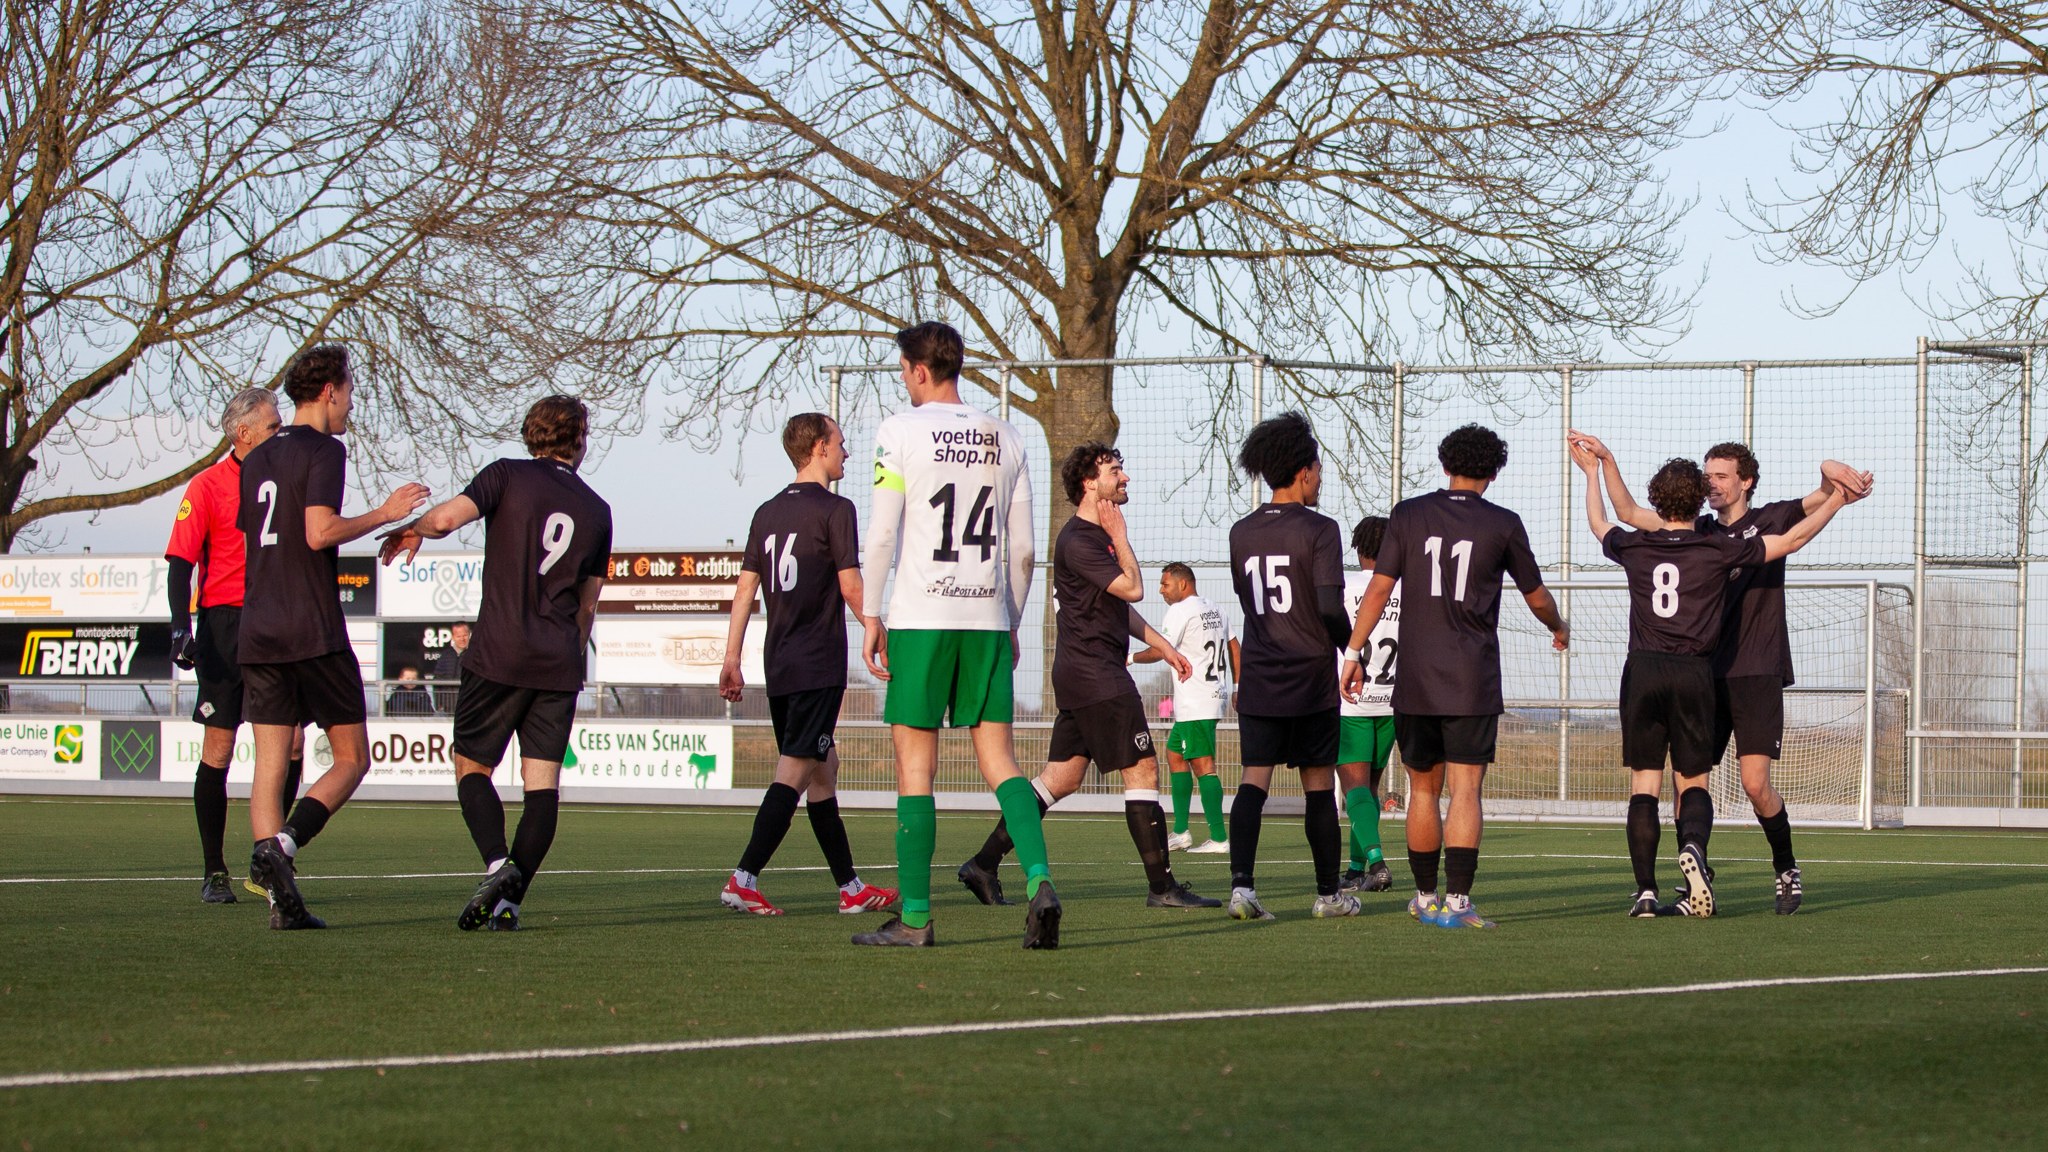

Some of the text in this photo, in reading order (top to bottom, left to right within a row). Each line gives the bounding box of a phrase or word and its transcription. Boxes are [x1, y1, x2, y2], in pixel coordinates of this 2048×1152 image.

[932, 429, 1000, 448] voetbal
[934, 445, 1001, 468] shop.nl
[257, 480, 278, 548] 2
[928, 483, 997, 563] 14
[538, 512, 575, 576] 9
[399, 561, 437, 583] Slof
[457, 561, 481, 583] Wi
[633, 556, 676, 578] Oude
[680, 556, 743, 580] Rechthu
[764, 533, 798, 592] 16
[1425, 536, 1473, 601] 11
[0, 564, 138, 594] olytex stoffen
[338, 574, 369, 588] ntage
[1244, 555, 1292, 615] 15
[1652, 562, 1679, 618] 8
[339, 590, 354, 602] 88
[655, 588, 690, 598] Feestzaal
[699, 588, 725, 599] Slijterij
[634, 603, 719, 611] www.hetouderechthuis.nl
[75, 625, 139, 640] montagebedrijf
[39, 640, 140, 676] BERRY
[1203, 639, 1227, 681] 24
[16, 724, 48, 740] Unie
[579, 728, 611, 751] CEES
[652, 729, 707, 752] SCHAIK
[10, 746, 48, 759] Company
[371, 734, 455, 764] oDeR
[428, 767, 457, 776] waterbo
[579, 759, 694, 777] veehouder
